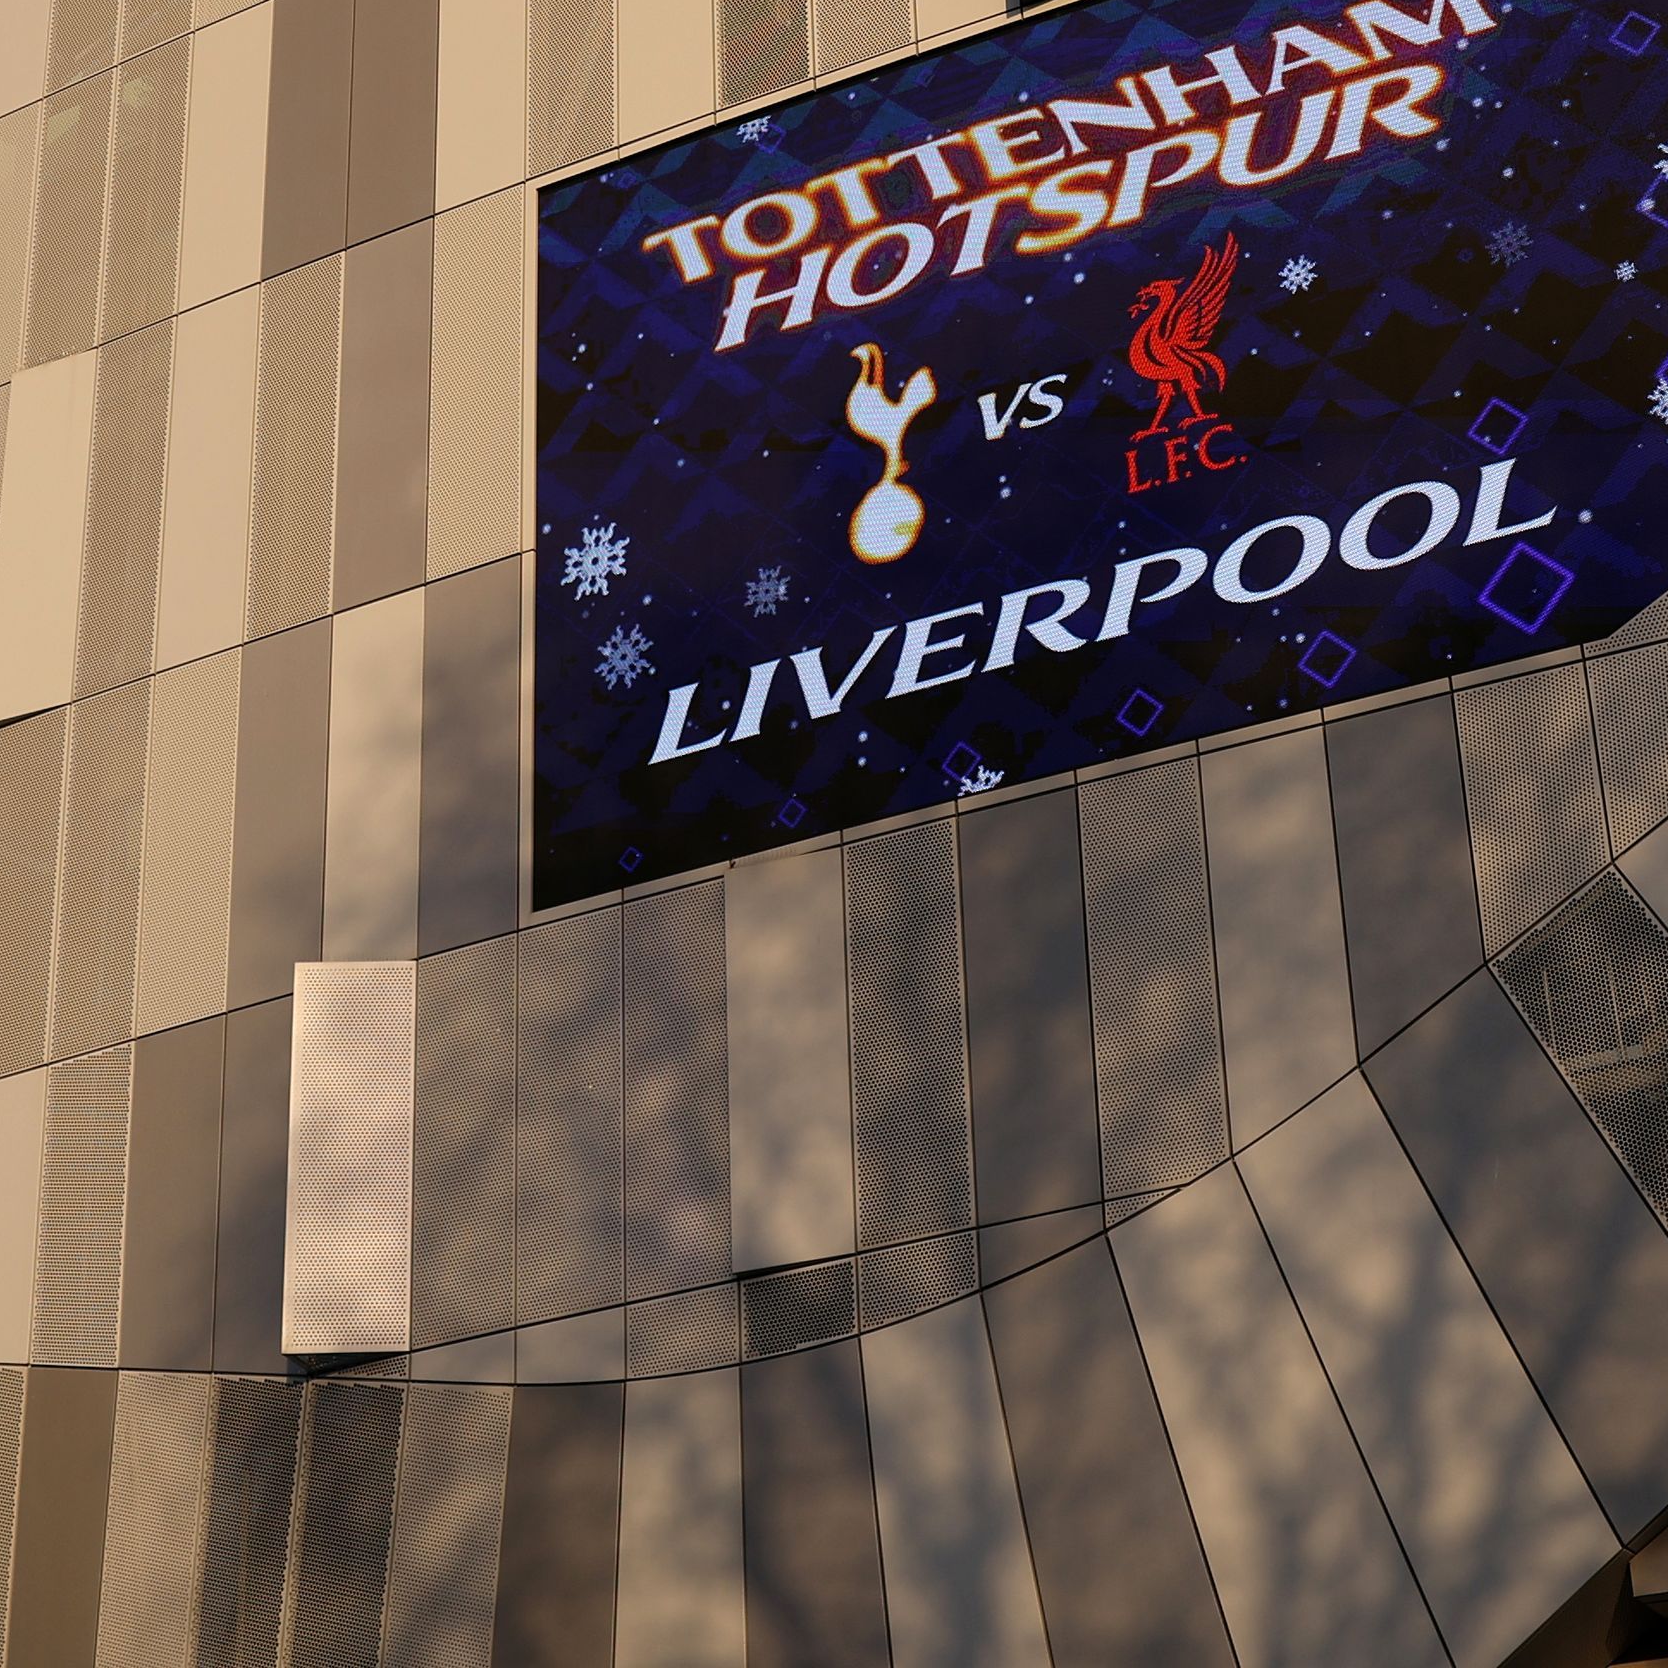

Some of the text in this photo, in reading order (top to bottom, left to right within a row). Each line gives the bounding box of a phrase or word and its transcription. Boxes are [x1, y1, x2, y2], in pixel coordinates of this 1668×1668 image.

[712, 62, 1442, 352] HOTSPUR
[1125, 423, 1248, 494] L.F.C.
[647, 458, 1557, 765] LIVERPOOL
